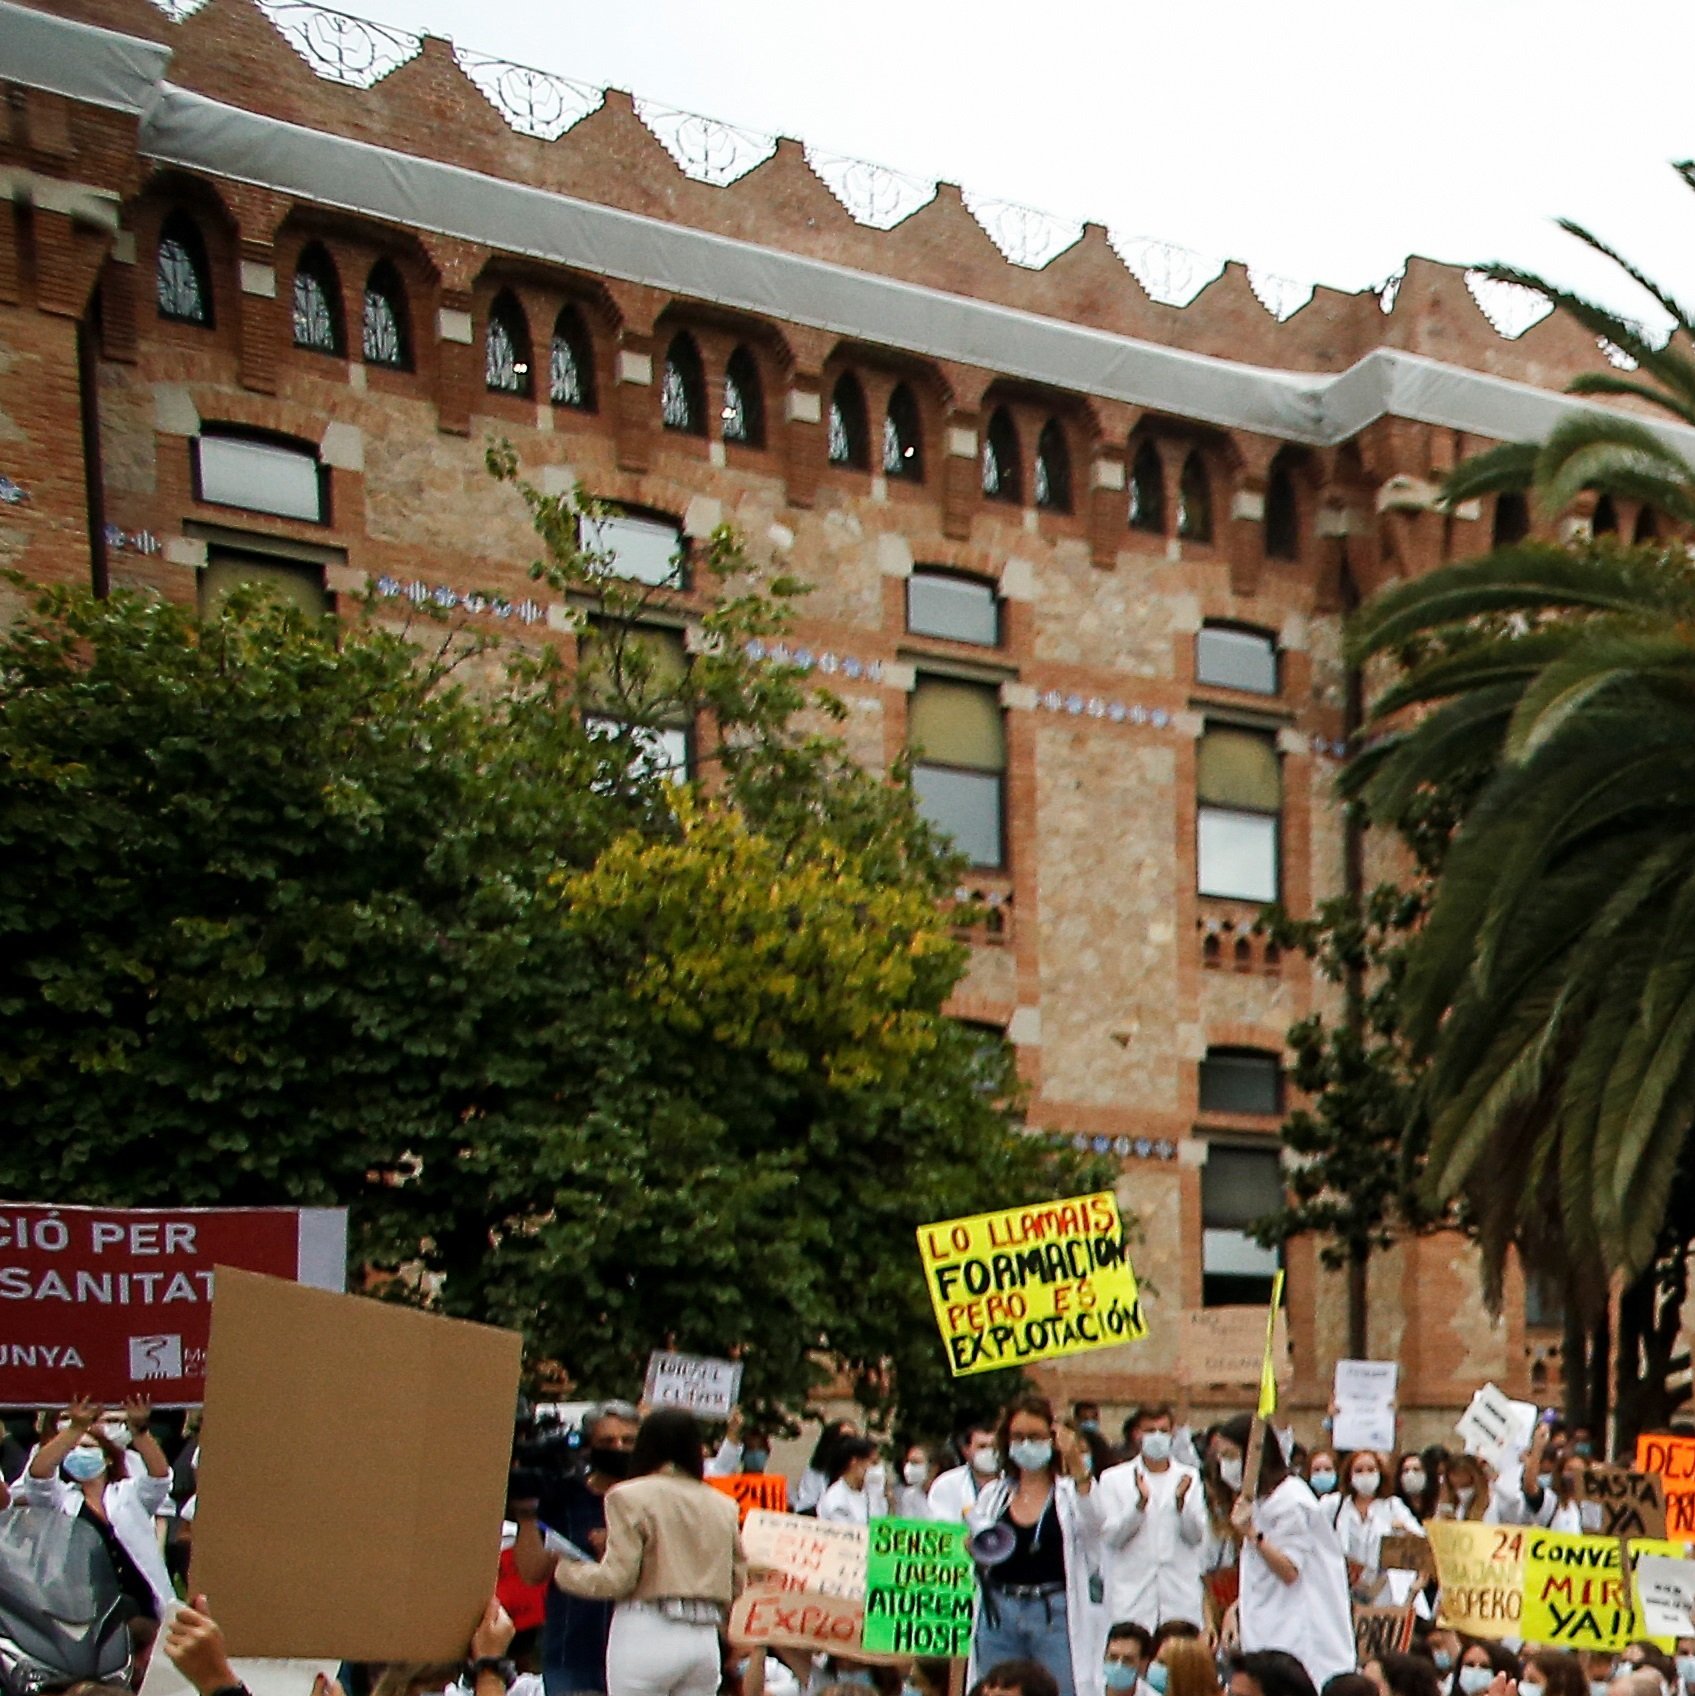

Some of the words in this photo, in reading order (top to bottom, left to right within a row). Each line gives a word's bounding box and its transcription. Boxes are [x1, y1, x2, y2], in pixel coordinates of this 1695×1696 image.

[92, 1221, 198, 1255] PER
[928, 1226, 971, 1261] LO
[987, 1194, 1115, 1248] LLAMAIS
[0, 1267, 215, 1305] SANITAT
[947, 1292, 1027, 1334] PERO
[1055, 1277, 1097, 1314] ES
[951, 1298, 1143, 1370] EXPLOTACIÓN
[1583, 1471, 1658, 1510] BASTA
[1603, 1502, 1645, 1536] YA
[875, 1523, 953, 1556] SENSE
[1491, 1530, 1522, 1564] 24
[868, 1588, 974, 1618] ATUREM
[1541, 1574, 1624, 1607] MIR
[744, 1597, 864, 1645] EXPLO
[893, 1620, 972, 1655] HOSP
[1548, 1602, 1635, 1649] YA!!
